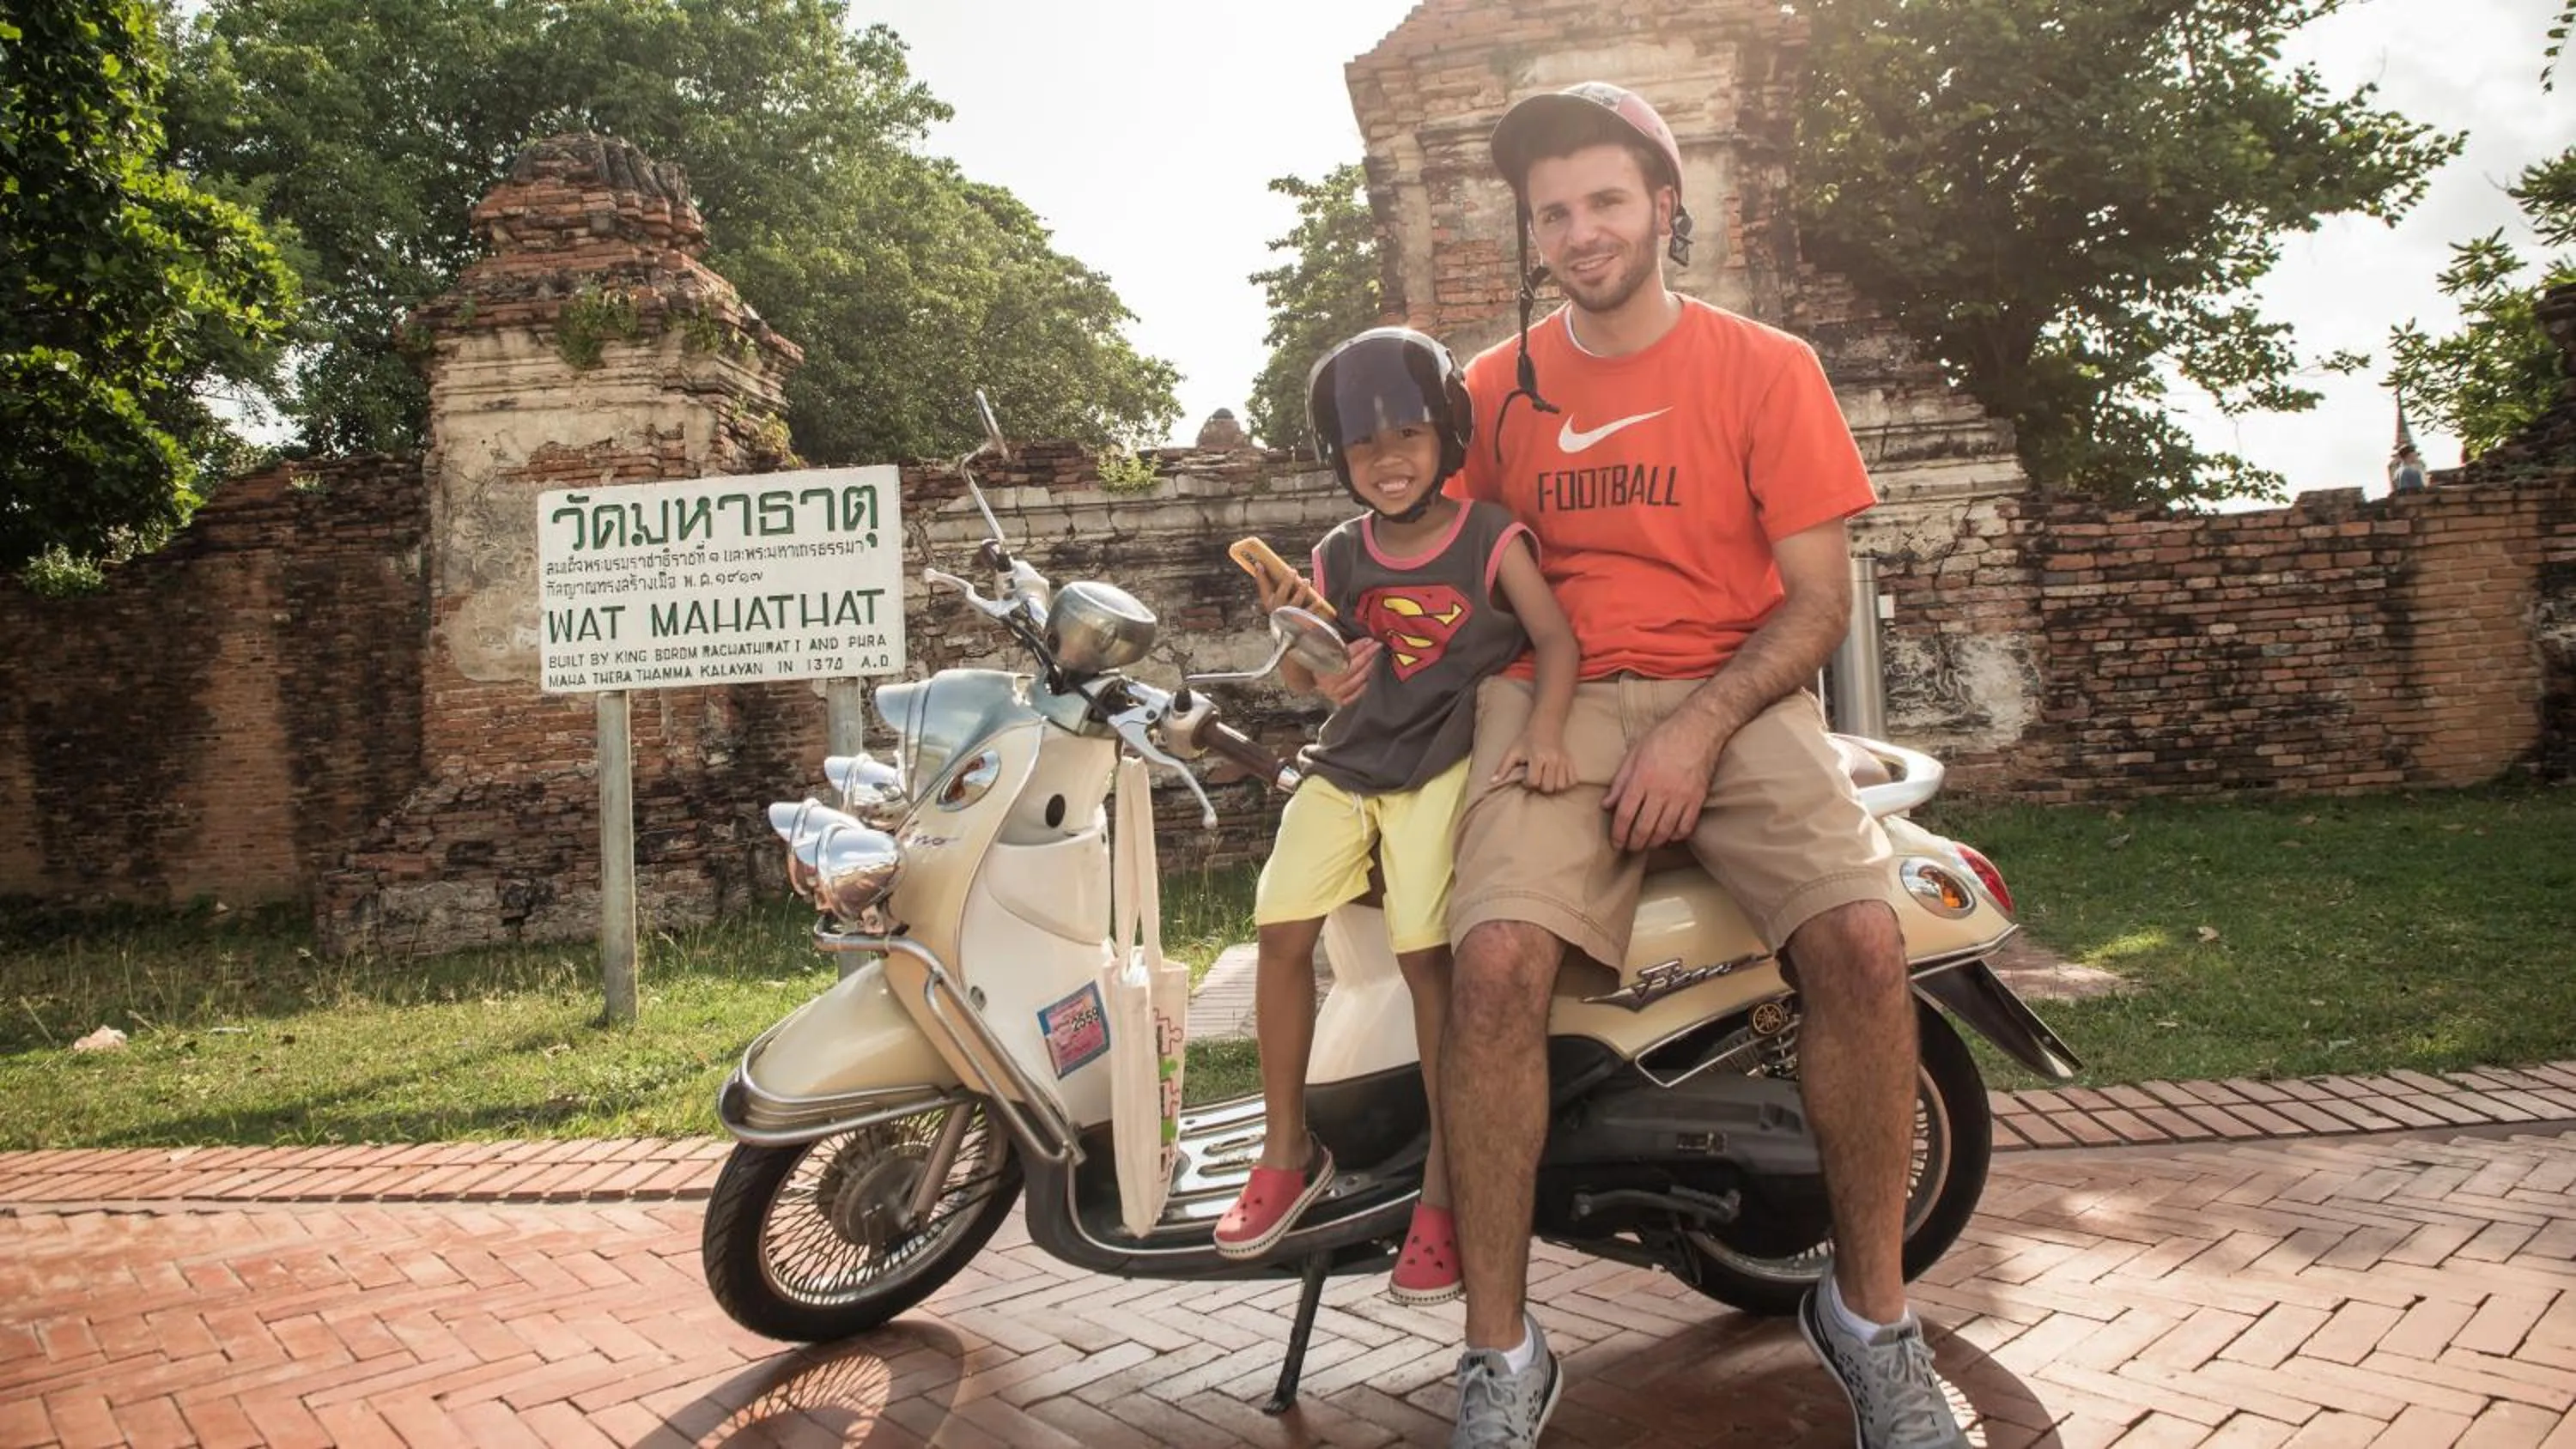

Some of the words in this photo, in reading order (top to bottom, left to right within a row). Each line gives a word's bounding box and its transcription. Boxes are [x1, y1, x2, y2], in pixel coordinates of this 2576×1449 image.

[1538, 464, 1682, 512] FOOTBALL
[552, 484, 879, 551] วัดมหาธาตุ
[549, 605, 626, 644] WAT
[651, 589, 884, 637] MAHATHAT
[549, 653, 585, 670] BUILT
[590, 652, 609, 666] BY
[615, 650, 647, 664] KING
[655, 646, 698, 662] BOROM
[809, 637, 839, 652] AND
[848, 634, 887, 648] PHRA
[549, 672, 586, 688] MAHA
[592, 668, 633, 685] THERA
[636, 664, 693, 682] THAMMA
[700, 661, 763, 678] KALAYAN
[777, 659, 793, 673] IN
[807, 657, 843, 671] 1374
[1071, 1006, 1099, 1032] 2559
